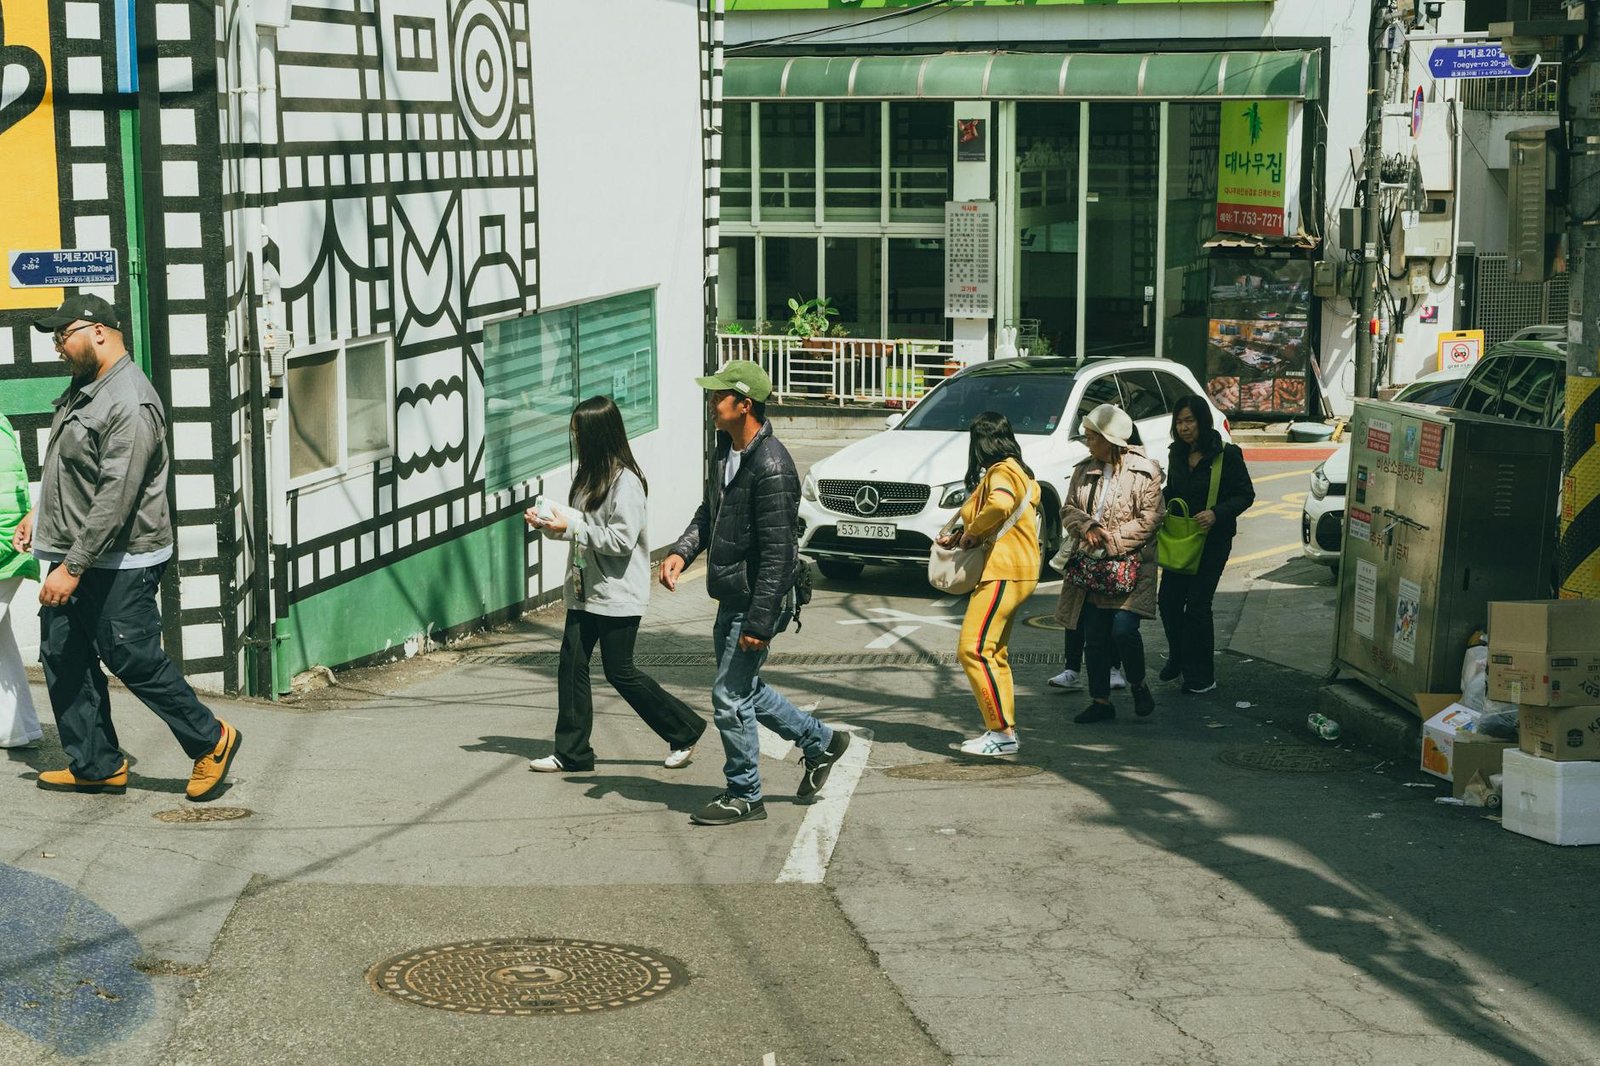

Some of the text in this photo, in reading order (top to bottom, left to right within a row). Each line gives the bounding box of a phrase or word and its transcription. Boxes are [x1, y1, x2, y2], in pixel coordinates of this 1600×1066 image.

[1434, 59, 1444, 67] 27
[1453, 61, 1489, 69] Toegye-ro
[1225, 150, 1282, 183] 대나무집
[1233, 210, 1282, 228] T.753-7271
[53, 251, 113, 263] 퇴계로20나길
[55, 264, 114, 274] Toegye-ro 20na-gil
[863, 525, 890, 537] 9783
